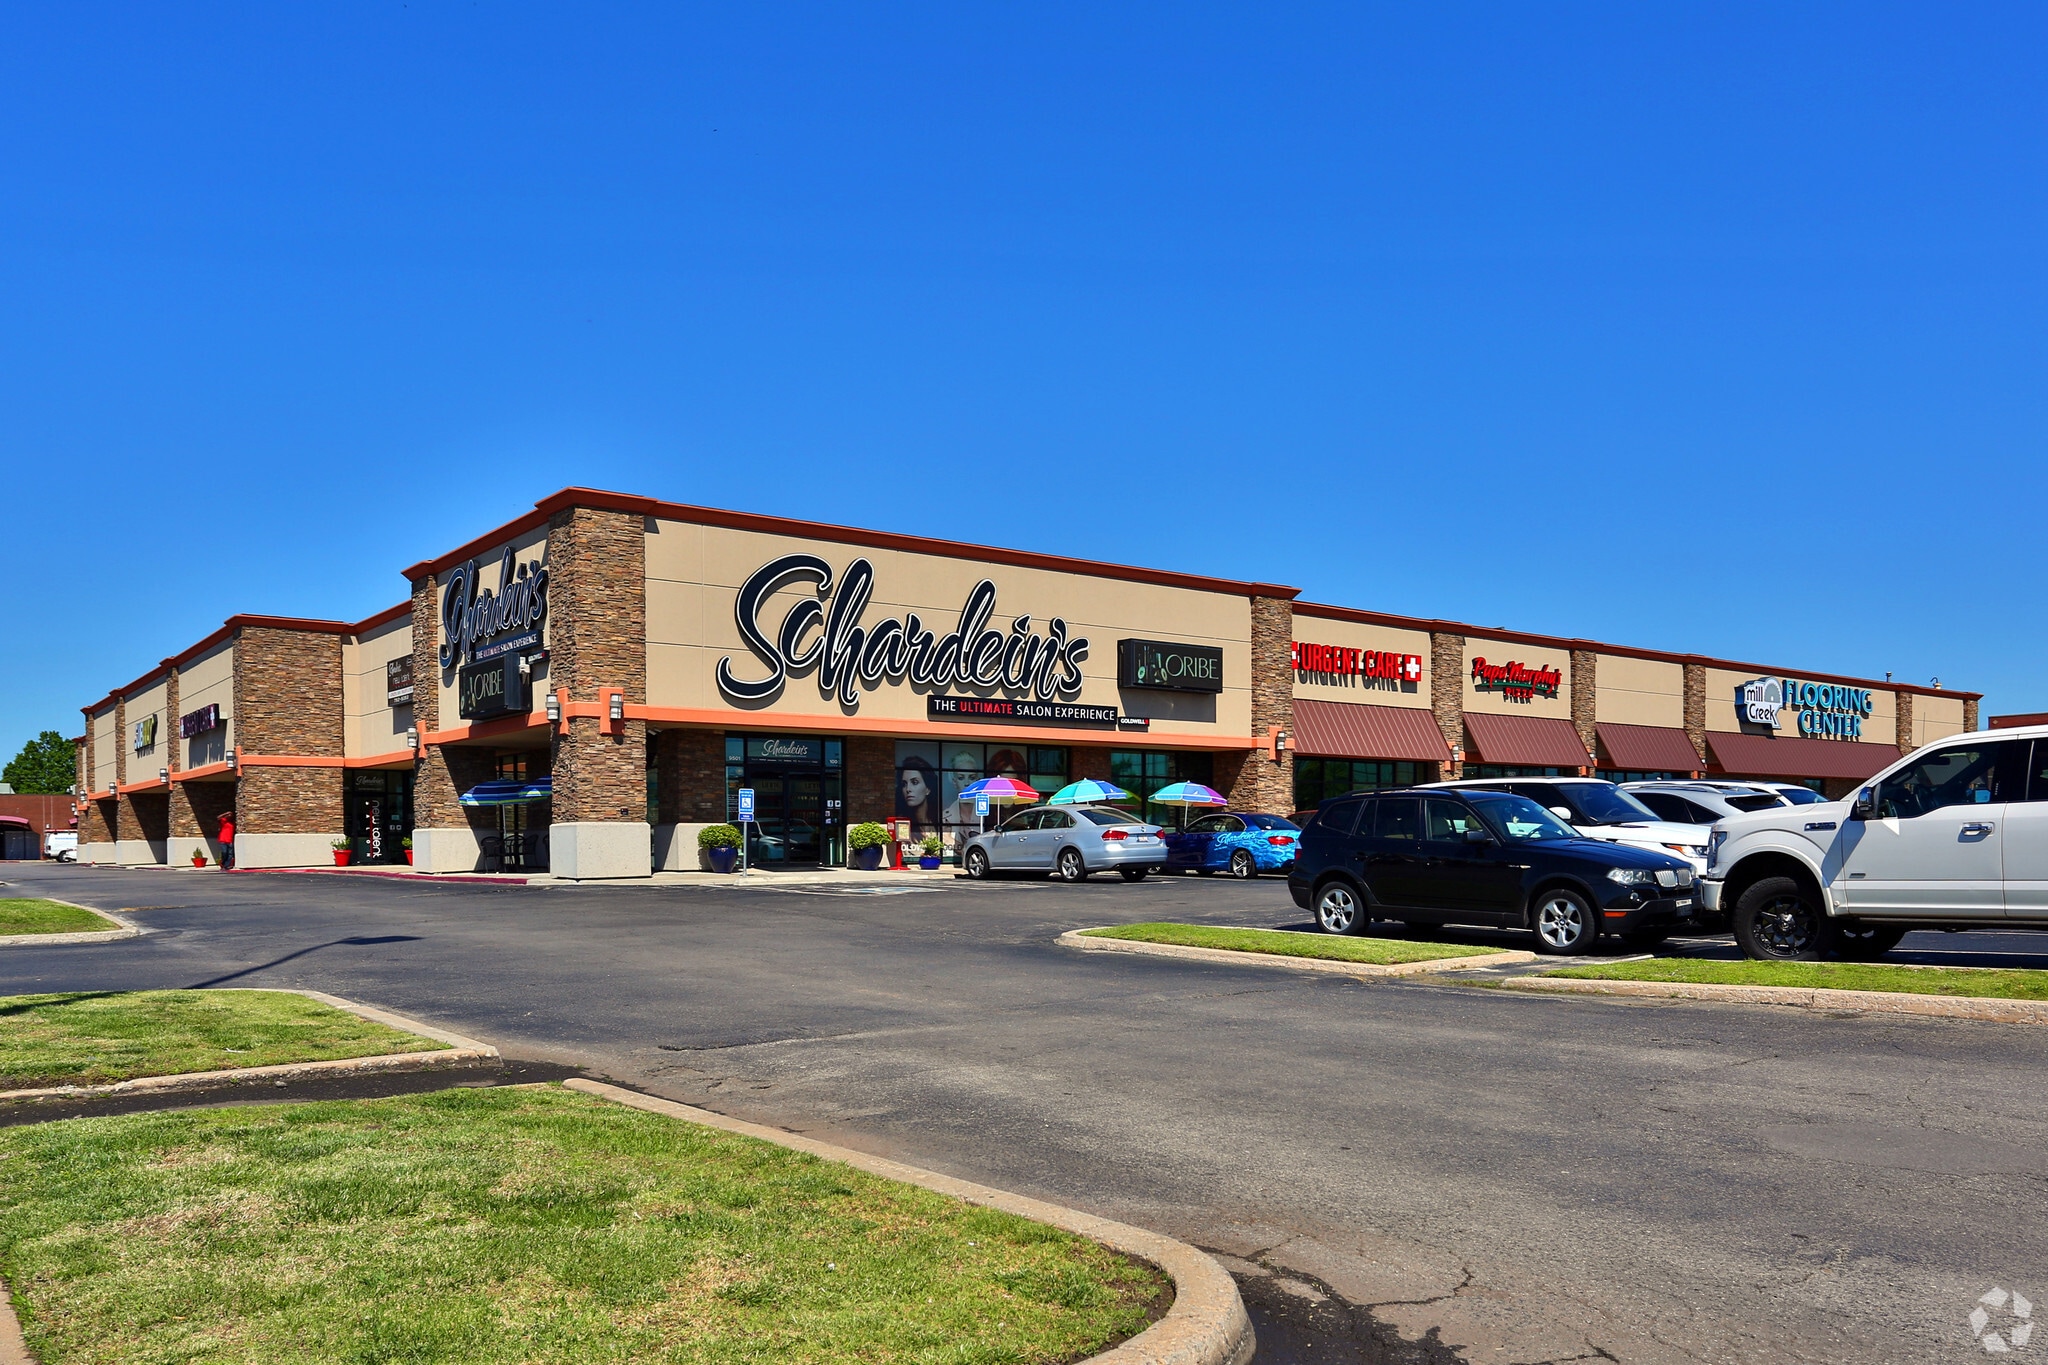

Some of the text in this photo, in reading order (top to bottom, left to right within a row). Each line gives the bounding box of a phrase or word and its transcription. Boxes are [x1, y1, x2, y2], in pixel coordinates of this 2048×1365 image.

[716, 554, 1090, 705] Schardein's
[1165, 654, 1219, 680] ORIBE
[1300, 642, 1402, 680] URGENT CARE
[1473, 656, 1562, 694] Papa Murphy's
[474, 669, 503, 700] ORIBE
[1504, 687, 1533, 698] PIZZA
[1746, 686, 1763, 702] mill
[1783, 679, 1873, 713] FLOORING
[935, 700, 1115, 721] THE ULTIMATE SALON EXPERIENCE
[1748, 703, 1778, 727] Creek
[1798, 709, 1863, 737] CENTER
[761, 739, 808, 757] Schardein's
[371, 800, 382, 858] new talent
